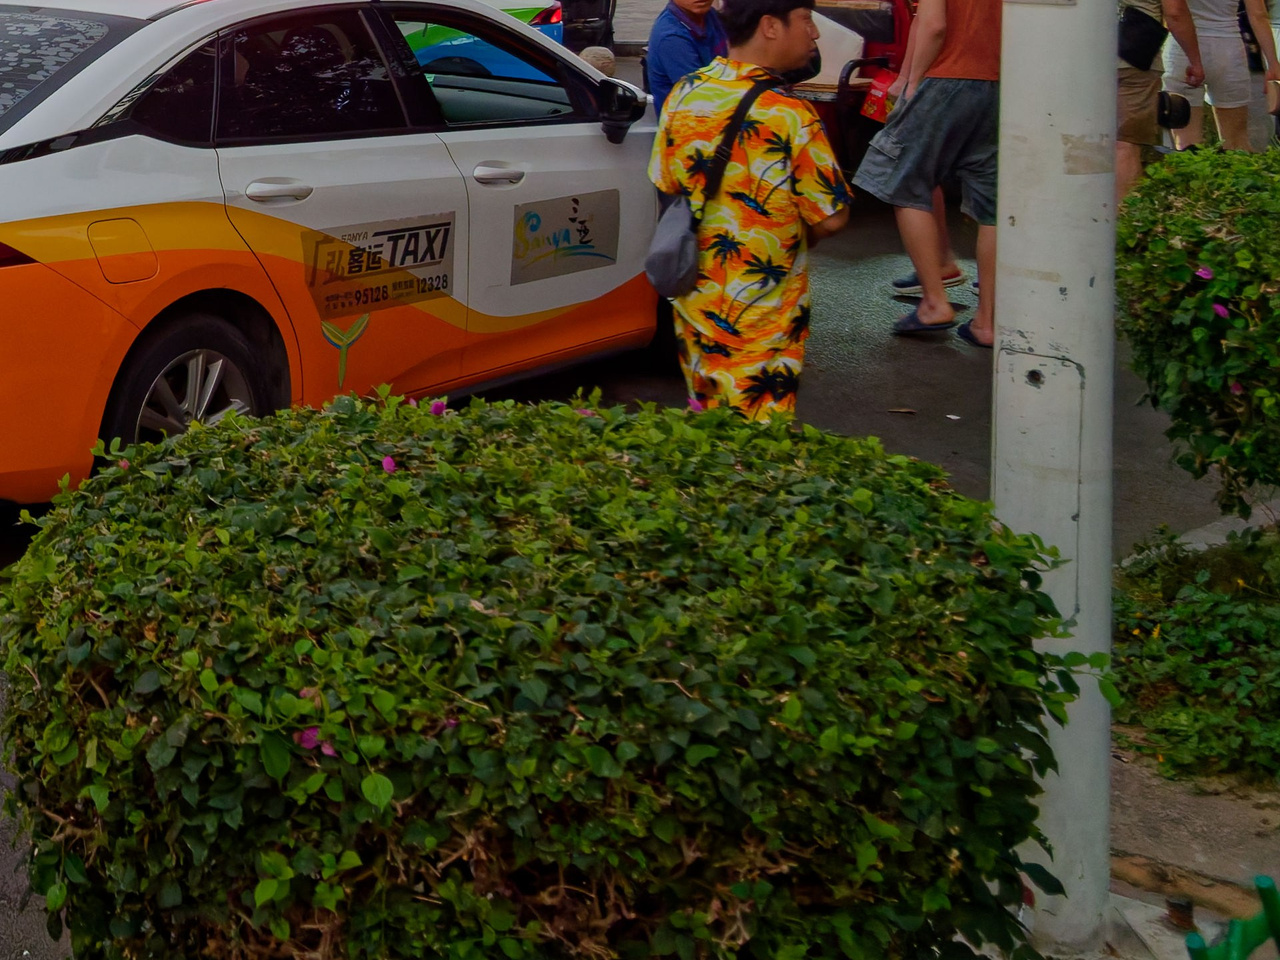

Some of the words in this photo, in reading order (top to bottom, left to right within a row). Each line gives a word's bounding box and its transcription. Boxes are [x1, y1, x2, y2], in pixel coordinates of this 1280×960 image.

[341, 231, 369, 242] SANYA
[387, 227, 450, 268] TAXI
[354, 284, 389, 305] 95128
[416, 273, 449, 295] 12328
